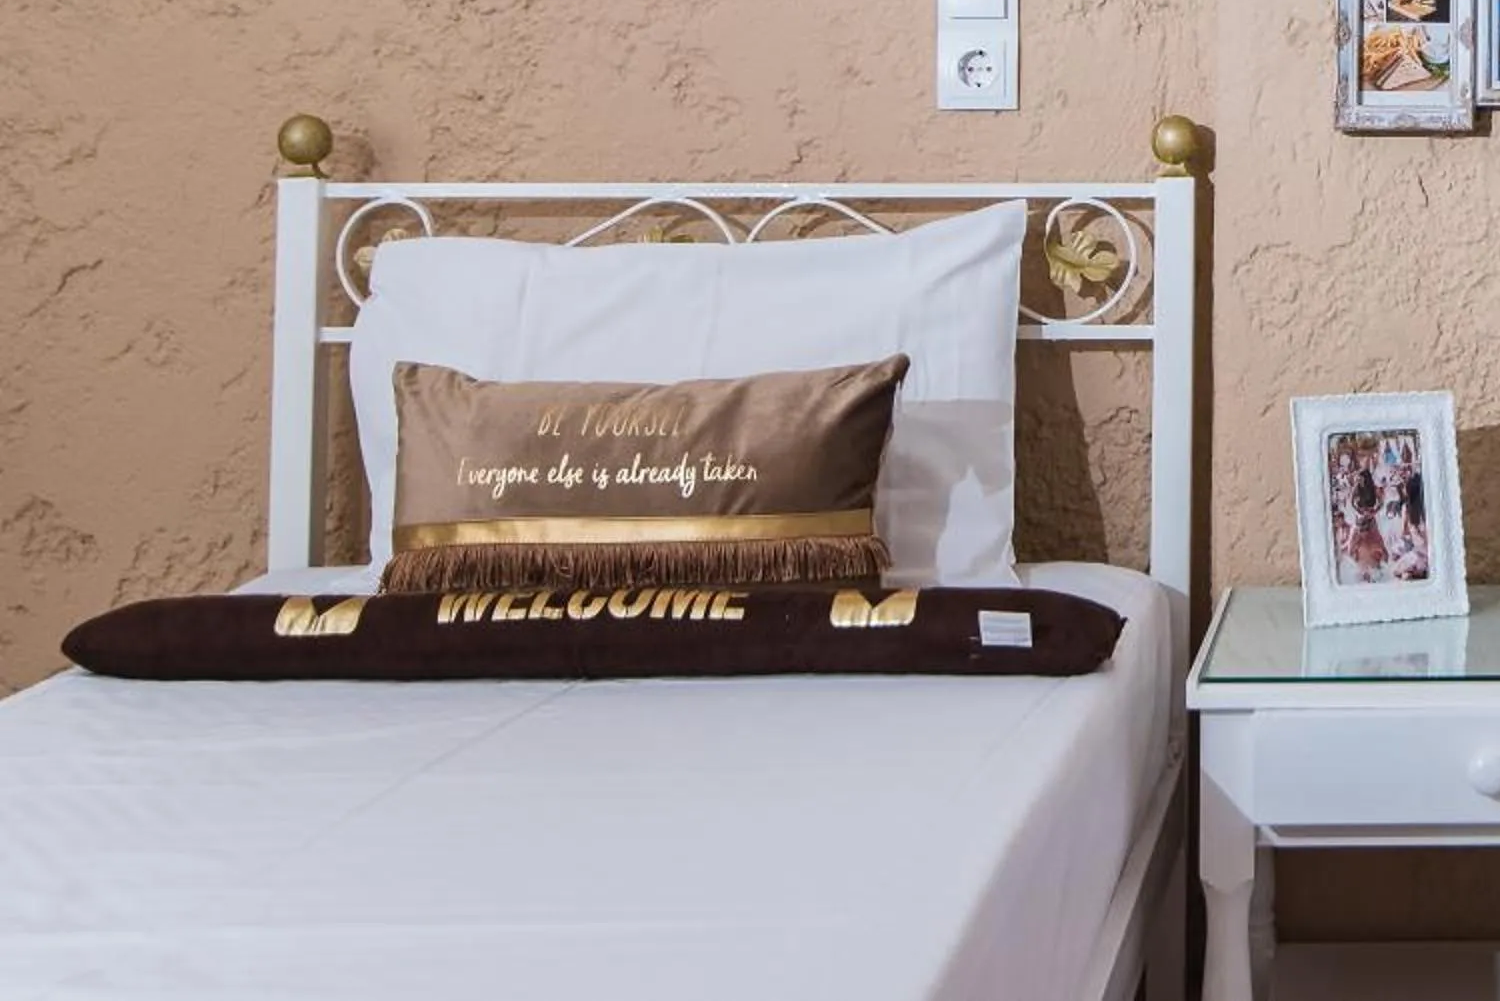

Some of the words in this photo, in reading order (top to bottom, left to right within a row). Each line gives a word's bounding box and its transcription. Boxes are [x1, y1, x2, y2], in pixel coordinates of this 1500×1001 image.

[581, 402, 690, 436] YOURSEL
[456, 457, 539, 499] Everyone
[547, 452, 584, 489] else
[591, 458, 610, 490] is
[615, 451, 697, 498] already
[699, 451, 758, 482] taken
